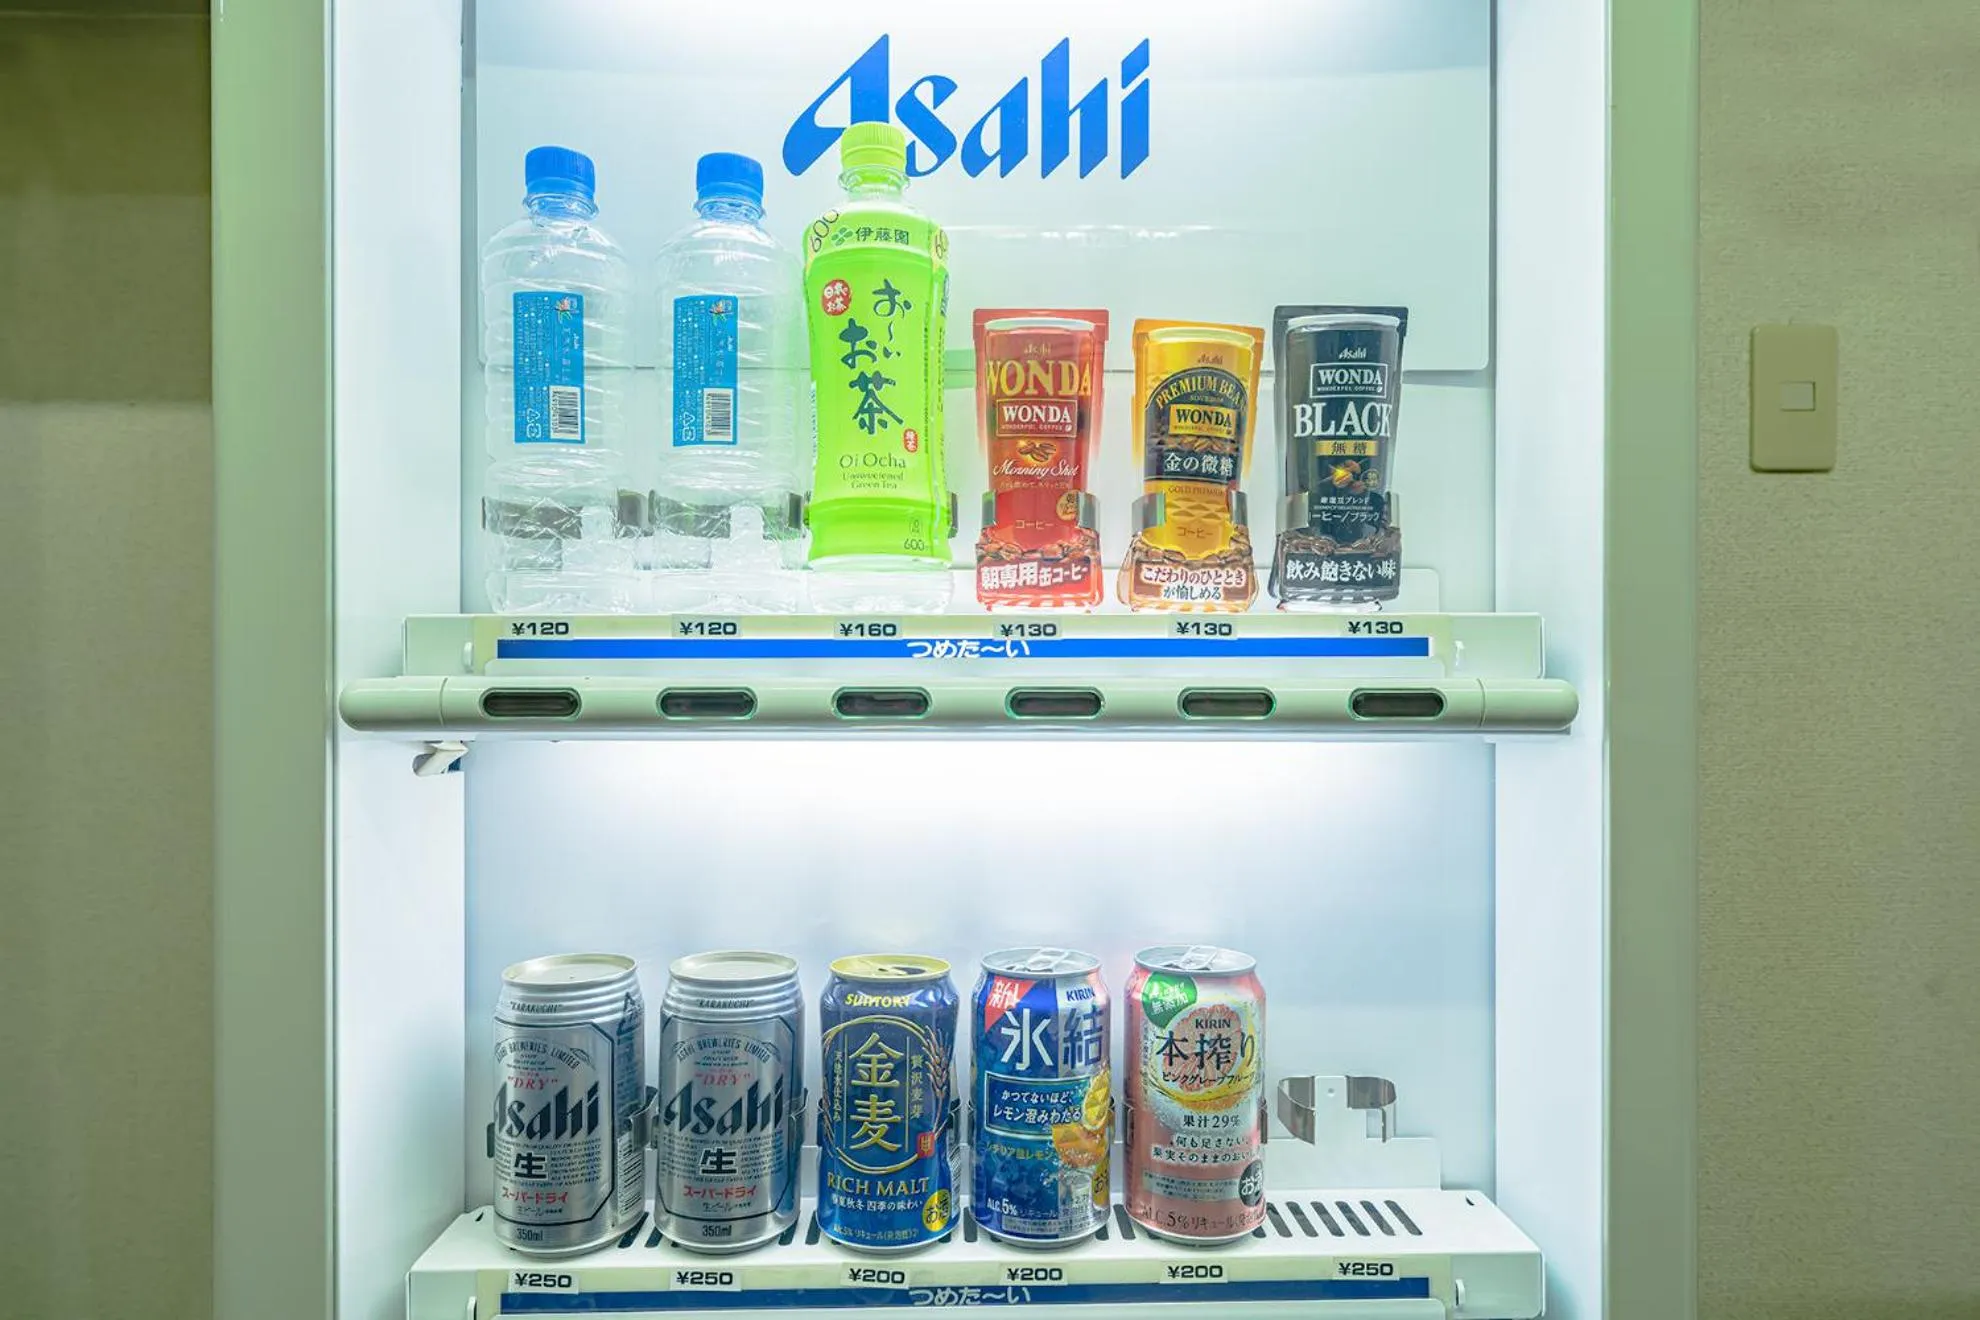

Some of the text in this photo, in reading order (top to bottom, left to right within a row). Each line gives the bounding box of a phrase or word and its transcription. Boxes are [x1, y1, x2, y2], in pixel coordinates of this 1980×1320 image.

[782, 33, 1149, 179] Asahi
[855, 227, 909, 245] 伊藤園
[1338, 347, 1367, 360] Asahi
[839, 317, 903, 435] お茶
[1318, 368, 1383, 385] WONDA
[1156, 376, 1217, 410] PREMIUM
[1002, 405, 1072, 423] WONDA
[1175, 408, 1233, 429] WONDA
[1293, 401, 1393, 438] BLACK
[840, 452, 906, 469] Oi Ocha
[1163, 452, 1234, 477] 金の微糖
[993, 458, 1050, 479] Morning
[1309, 511, 1380, 523] ーヒー/ブラック
[1016, 520, 1054, 530] コーヒー
[1177, 526, 1214, 539] コーヒー
[980, 561, 1089, 590] 朝専用缶コーヒー
[1142, 567, 1246, 586] こだわりのひととき
[1286, 560, 1397, 582] 飲み飽きない味
[1163, 586, 1222, 600] が愉しめる
[512, 622, 569, 636] ¥120
[680, 622, 737, 636] ¥120
[840, 623, 897, 637] ¥160
[1001, 623, 1057, 637] ¥130
[1176, 622, 1233, 636] ¥130
[1348, 621, 1404, 635] ¥130
[845, 993, 911, 1008] SUNTORY
[1066, 987, 1096, 1002] KIRIN
[1195, 1018, 1231, 1030] KIRIN
[1000, 1004, 1103, 1070] 氷結
[1155, 1030, 1255, 1070] 本搾り
[848, 1032, 905, 1151] 金麦
[1001, 1090, 1073, 1104] かつてないほど、
[494, 1082, 600, 1140] Asahi
[664, 1074, 783, 1136] Asahi
[993, 1104, 1082, 1124] レモン澄みわたる
[1183, 1115, 1240, 1128] 果汁29%
[514, 1152, 547, 1179] 生
[700, 1148, 737, 1175] 生
[683, 1185, 757, 1199] スーパードライ
[827, 1172, 930, 1197] RICH MALT
[867, 1200, 924, 1213] 四季の味わい
[516, 1229, 544, 1242] 350ml
[702, 1225, 732, 1238] 350ml
[849, 1269, 905, 1285] ¥200
[1007, 1267, 1063, 1281] ¥200
[1167, 1265, 1224, 1279] ¥200
[1338, 1262, 1394, 1277] ¥250
[514, 1273, 573, 1288] ¥250
[676, 1271, 734, 1286] ¥250
